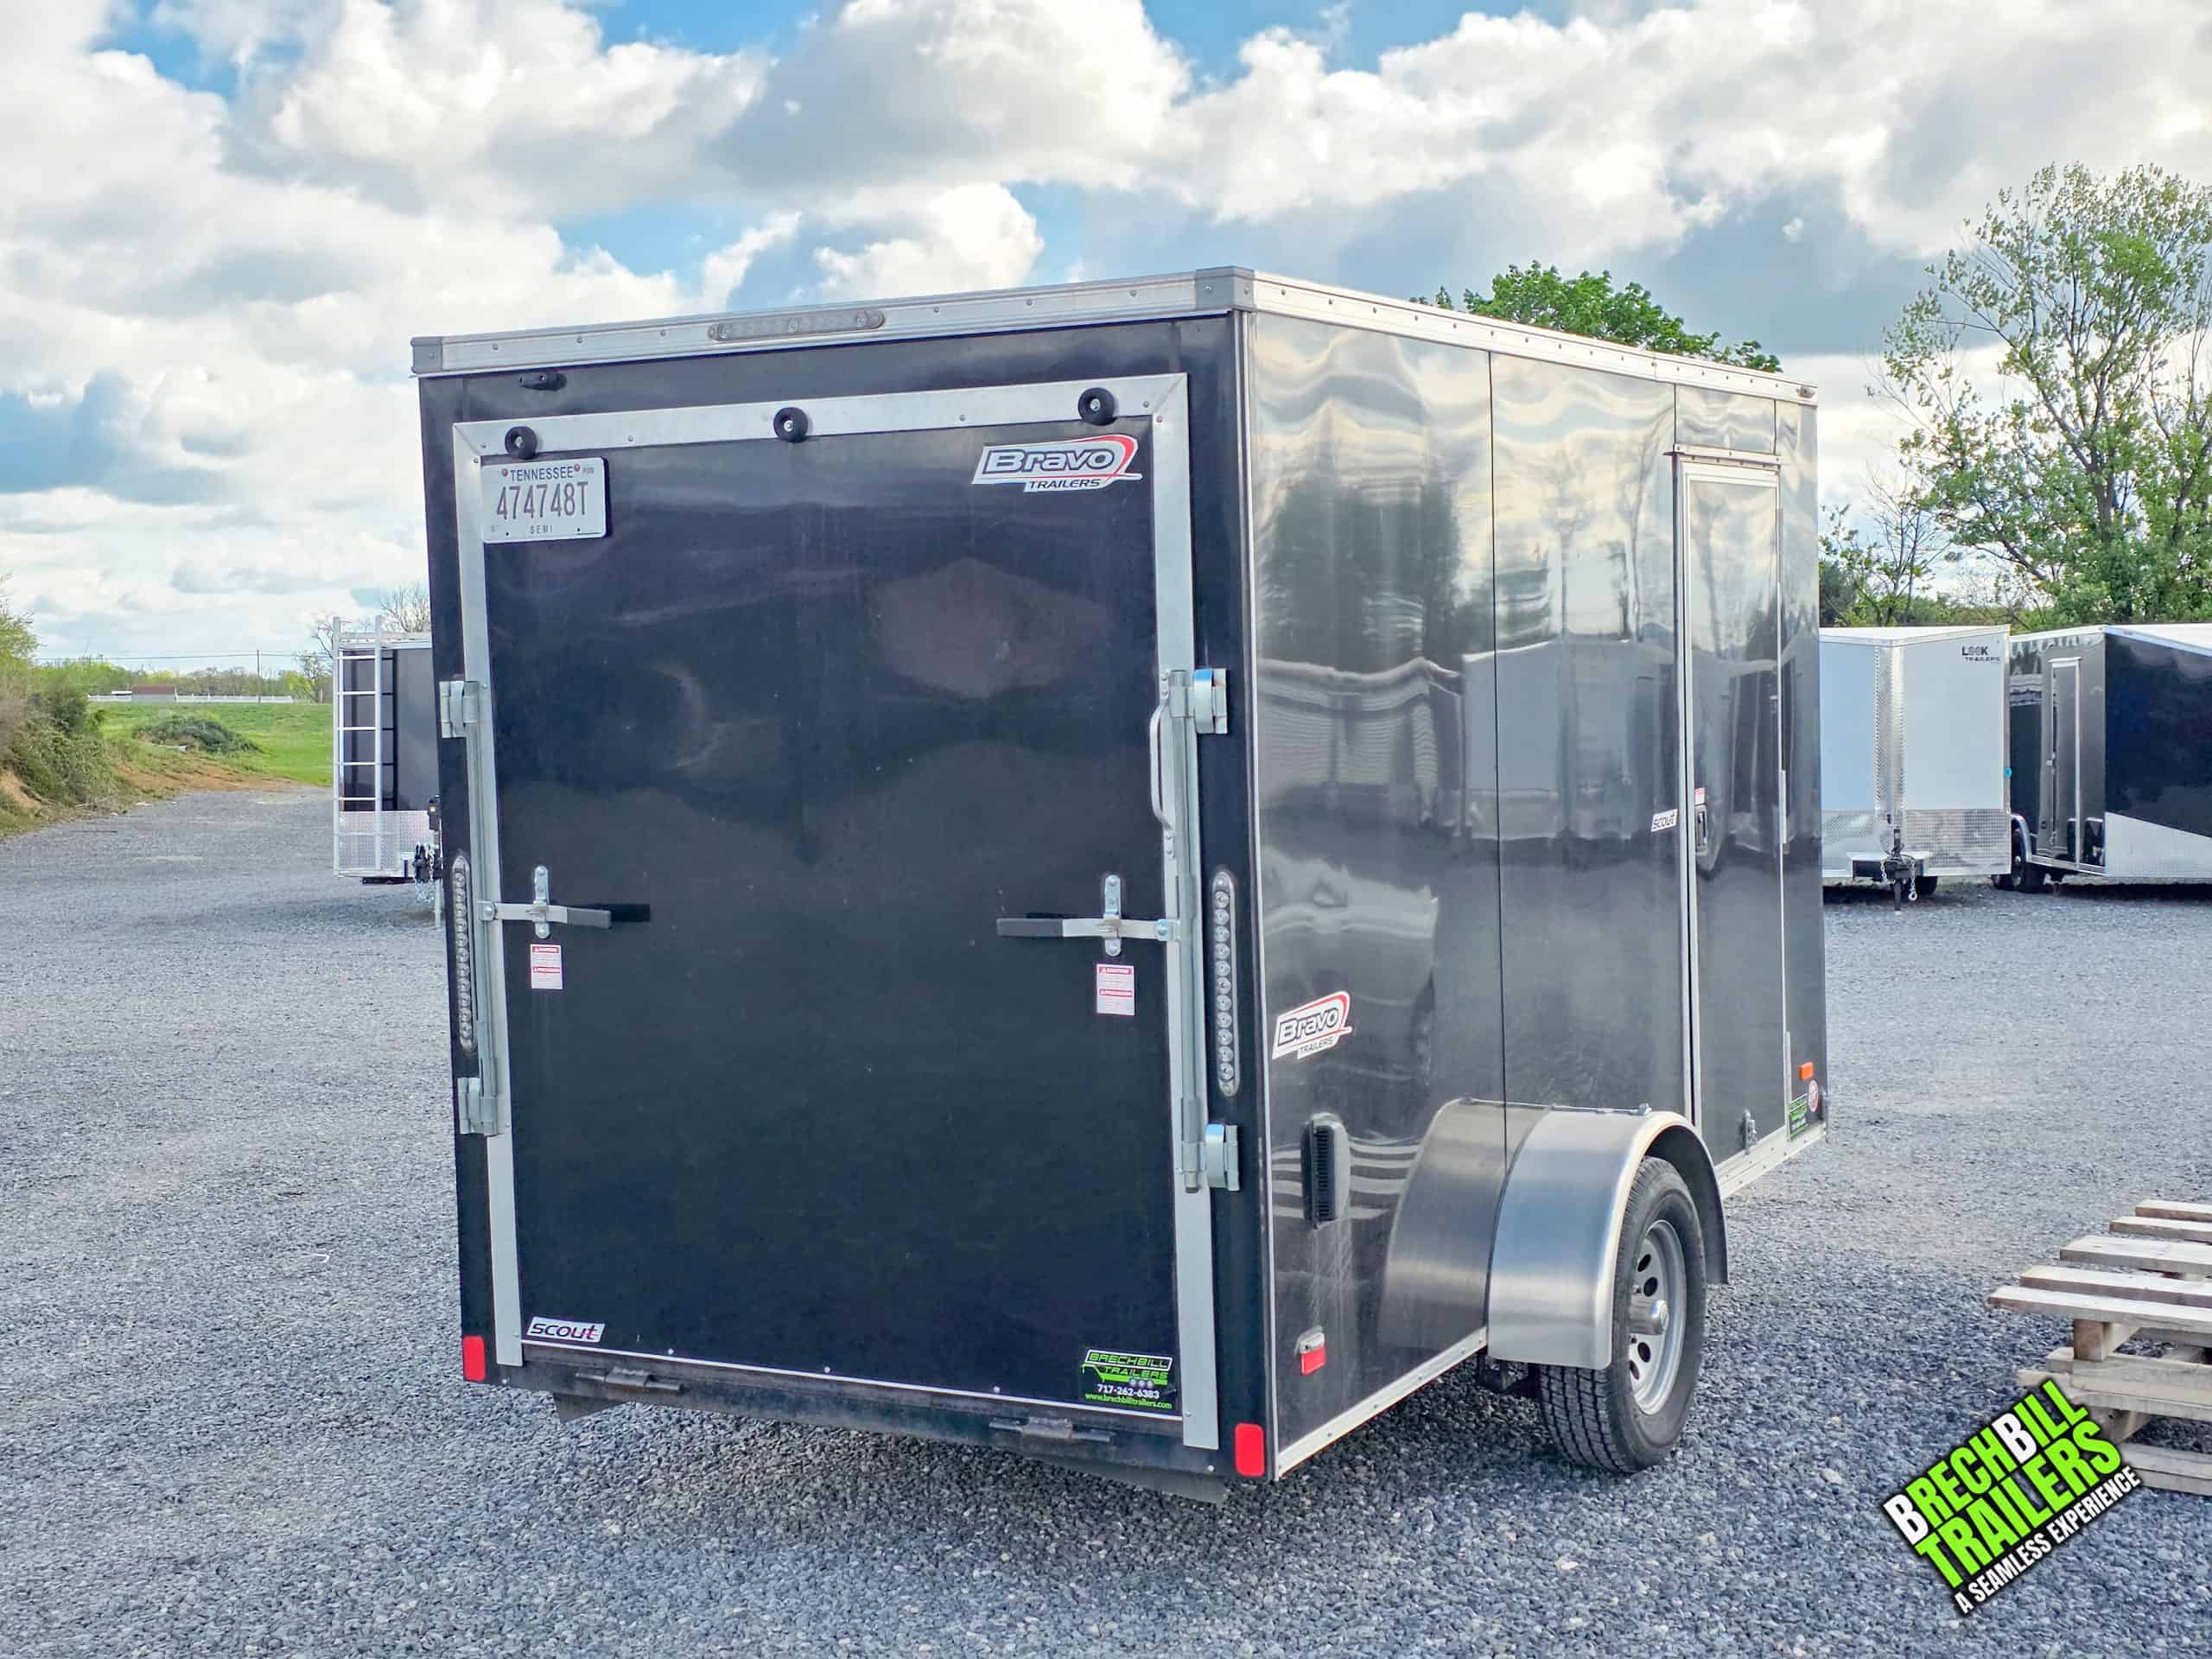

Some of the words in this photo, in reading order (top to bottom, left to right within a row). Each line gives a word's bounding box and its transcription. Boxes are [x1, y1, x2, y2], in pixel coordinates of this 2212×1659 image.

[982, 448, 1115, 474] Bravo
[510, 466, 575, 481] TENNESSEE
[1029, 479, 1101, 489] TRAILERS
[497, 481, 589, 520] 474748T
[530, 524, 553, 534] SEMI
[1961, 645, 1988, 656] LOOK
[1278, 1007, 1339, 1046] Bravo
[1300, 1037, 1334, 1052] TRAILERS
[1089, 1352, 1168, 1369] BRECHBILL
[1105, 1366, 1168, 1380] TRAILERS
[1096, 1383, 1160, 1399] 717-262-6383
